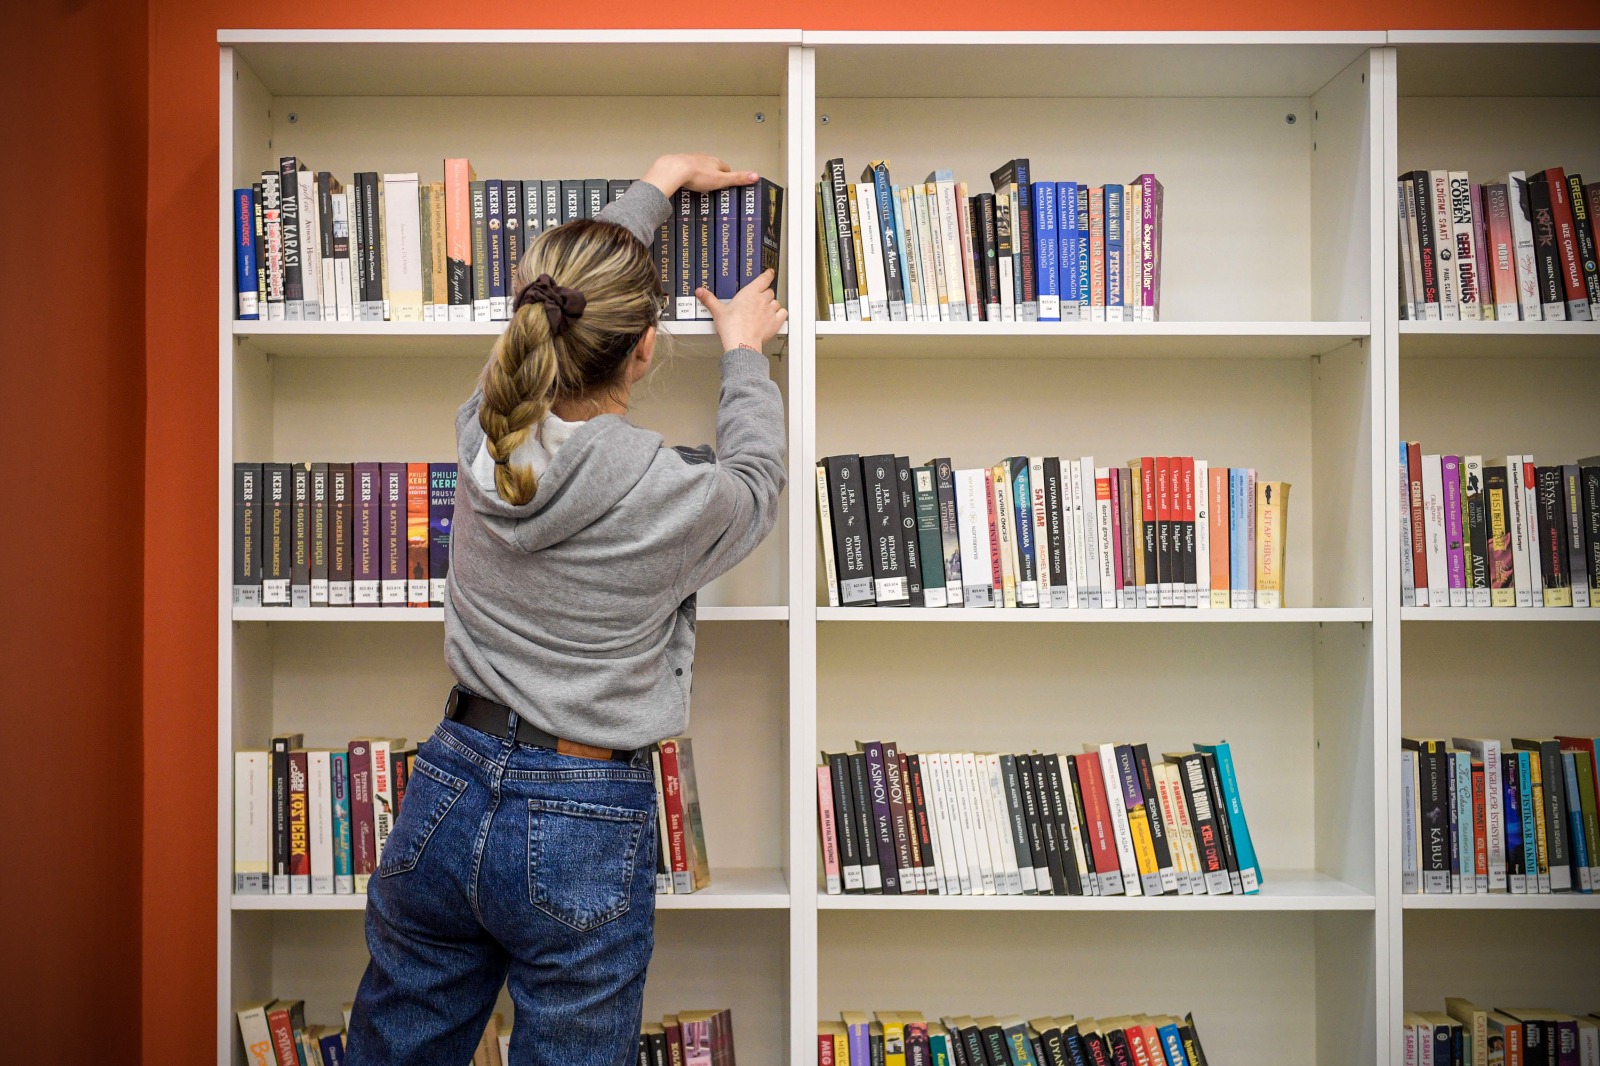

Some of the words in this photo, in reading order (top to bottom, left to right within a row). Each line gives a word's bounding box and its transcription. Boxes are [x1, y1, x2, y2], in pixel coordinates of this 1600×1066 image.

[832, 163, 844, 192] Ruth
[1018, 167, 1026, 184] ZADIE
[282, 195, 296, 218] YÜZ
[490, 190, 499, 214] KERR
[507, 190, 517, 214] KERR
[528, 190, 536, 215] KERR
[547, 190, 556, 214] KERR
[568, 192, 577, 218] KERR
[878, 164, 886, 190] CRAIG
[882, 192, 890, 222] RUSSELL
[1020, 186, 1028, 206] SMITH
[1110, 192, 1119, 217] WILBUR
[1436, 178, 1448, 214] ÖLDÜRME
[1451, 179, 1463, 224] COBEN
[1460, 179, 1472, 224] HARLAN
[1490, 190, 1498, 218] COOK
[1498, 190, 1506, 218] ROBIN
[1570, 178, 1586, 220] GREGOR
[241, 195, 251, 246] GÜMÜŞYÜZGEÇ
[474, 196, 482, 219] KERR
[837, 194, 850, 238] Rendell
[1047, 188, 1055, 230] ALEXANDER
[722, 224, 730, 256] ÖLÜMCÜL
[747, 224, 755, 256] ÖLÜMCÜL
[1440, 218, 1450, 240] SAATİ
[1562, 223, 1570, 238] BİZE
[284, 225, 298, 267] KARASI
[662, 244, 668, 254] VE
[1456, 232, 1474, 260] GERİ
[1563, 240, 1574, 260] ÇIKAN
[493, 261, 501, 286] DOKUZ
[662, 258, 670, 282] ÖTEKİ
[1080, 238, 1089, 306] MACERACILAR
[1110, 250, 1120, 304] FIRTINA
[1144, 261, 1152, 290] Dullar
[1423, 248, 1432, 285] Kalbimin
[1568, 262, 1580, 288] YOLLAR
[1460, 263, 1478, 304] DÖNÜŞ
[1549, 281, 1558, 301] COOK
[244, 475, 252, 501] KERR
[273, 475, 282, 501] KERR
[296, 476, 306, 501] KERR
[316, 476, 324, 502] KERR
[336, 476, 344, 502] KERR
[362, 476, 371, 502] KERR
[1020, 484, 1028, 518] NUMARALI
[1412, 481, 1422, 507] CERRAH
[840, 482, 848, 513] TOLKIEN
[845, 536, 855, 571] ÖYKÜLER
[874, 482, 883, 513] TOLKIEN
[880, 536, 890, 571] ÖYKÜLER
[1000, 518, 1008, 543] ÖNCESİ
[1022, 519, 1030, 548] KAMARA
[1160, 524, 1170, 552] Dalgalar
[1173, 524, 1182, 552] Dalgalar
[1263, 510, 1273, 538] KİTAP
[1414, 522, 1424, 553] GERRITSEN
[296, 540, 305, 565] SUÇLU
[854, 535, 864, 571] BİTMEMİŞ
[888, 535, 898, 571] BİTMEMİŞ
[1146, 525, 1156, 553] Dalgalar
[363, 537, 371, 574] KATLİAMI
[390, 537, 398, 574] KATLİAMI
[908, 540, 916, 569] HOBBIT
[1264, 541, 1272, 575] HIRSIZI
[376, 750, 385, 772] LAURIE
[1120, 752, 1130, 774] TONI
[1488, 748, 1498, 769] YİTİK
[888, 763, 902, 804] ASIMOV
[1124, 776, 1136, 798] BLAKE
[1186, 758, 1206, 792] SANDRA
[1431, 772, 1439, 802] GUNHUS
[870, 762, 886, 804] ASIMOV
[879, 815, 888, 844] VAKIF
[1148, 798, 1158, 822] RESİMLİ
[1158, 780, 1174, 826] FAHRENHEIT
[1172, 781, 1188, 826] FAHRENHEIT
[1192, 792, 1212, 822] BROWN
[1522, 794, 1533, 839] FISTIKLAR
[1552, 804, 1561, 819] ZALİM
[672, 814, 680, 830] Sana
[896, 816, 906, 842] İKİNCİ
[1152, 822, 1162, 838] ADAM
[1200, 825, 1212, 848] KİRLİ
[1431, 828, 1444, 869] KÂBUS
[900, 845, 910, 868] VAKIF
[1206, 848, 1220, 872] OYUN
[1526, 842, 1536, 872] TAKIMI
[822, 1040, 831, 1064] MEG
[968, 1033, 980, 1062] TRUVA
[989, 1033, 1003, 1060] BAHAR
[1406, 1034, 1414, 1060] SARAH
[1422, 1034, 1430, 1060] SARAH
[1561, 1028, 1572, 1054] KING
